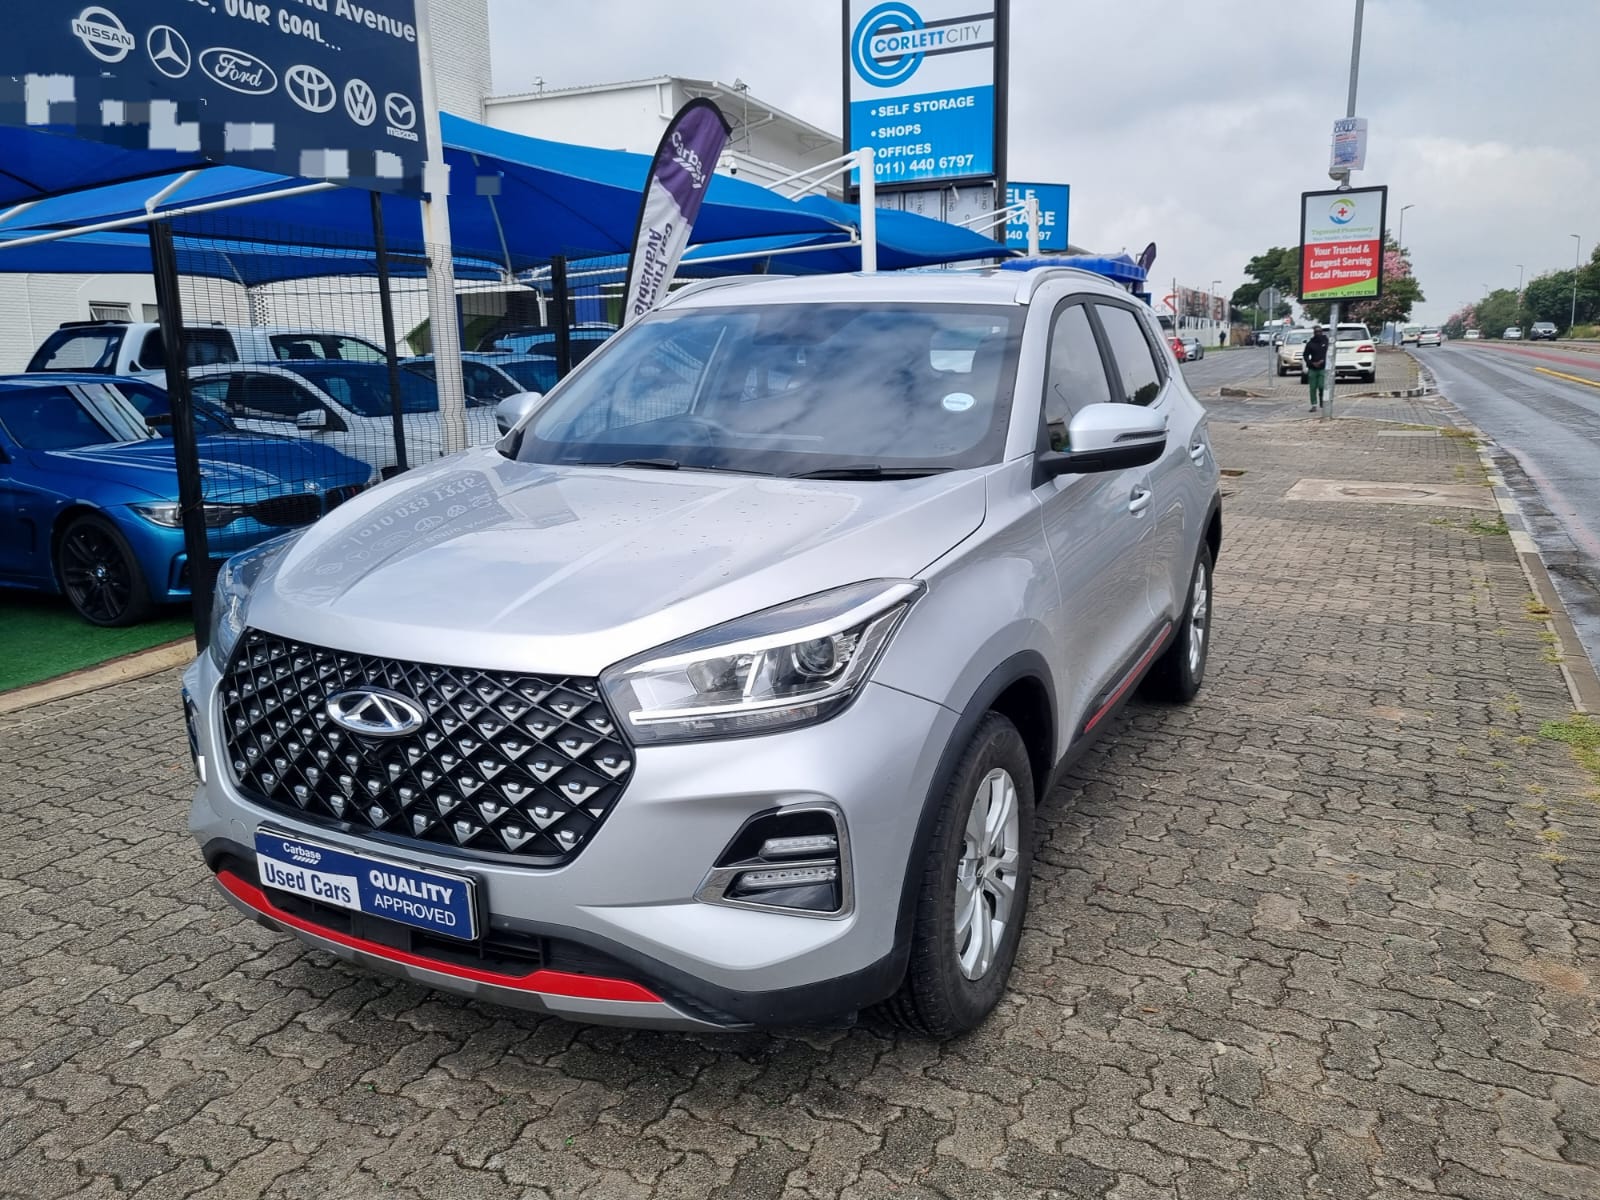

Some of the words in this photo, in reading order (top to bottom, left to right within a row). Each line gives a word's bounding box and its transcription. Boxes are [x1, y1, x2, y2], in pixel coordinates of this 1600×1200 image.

[335, 0, 416, 42] Avenue
[76, 23, 131, 46] NISSAN
[215, 54, 263, 87] Ford
[878, 104, 910, 117] SELF
[913, 96, 975, 113] STORAGE
[878, 124, 922, 138] SHOPS
[878, 143, 932, 158] OFFICES
[874, 161, 905, 175] 011)
[909, 158, 935, 171] 440
[939, 154, 974, 169] 6797
[1314, 247, 1331, 256] Your
[1333, 245, 1361, 255] Trusted
[1363, 244, 1370, 253] &
[635, 228, 662, 316] Available
[1310, 258, 1340, 270] Longest
[1342, 256, 1372, 267] Serving
[1310, 270, 1331, 280] Local
[1332, 269, 1371, 279] Pharmacy
[283, 842, 322, 860] Carbase
[264, 861, 306, 891] Used
[311, 873, 352, 903] Cars
[369, 869, 453, 905] QUALITY
[374, 893, 456, 927] APPROVED
